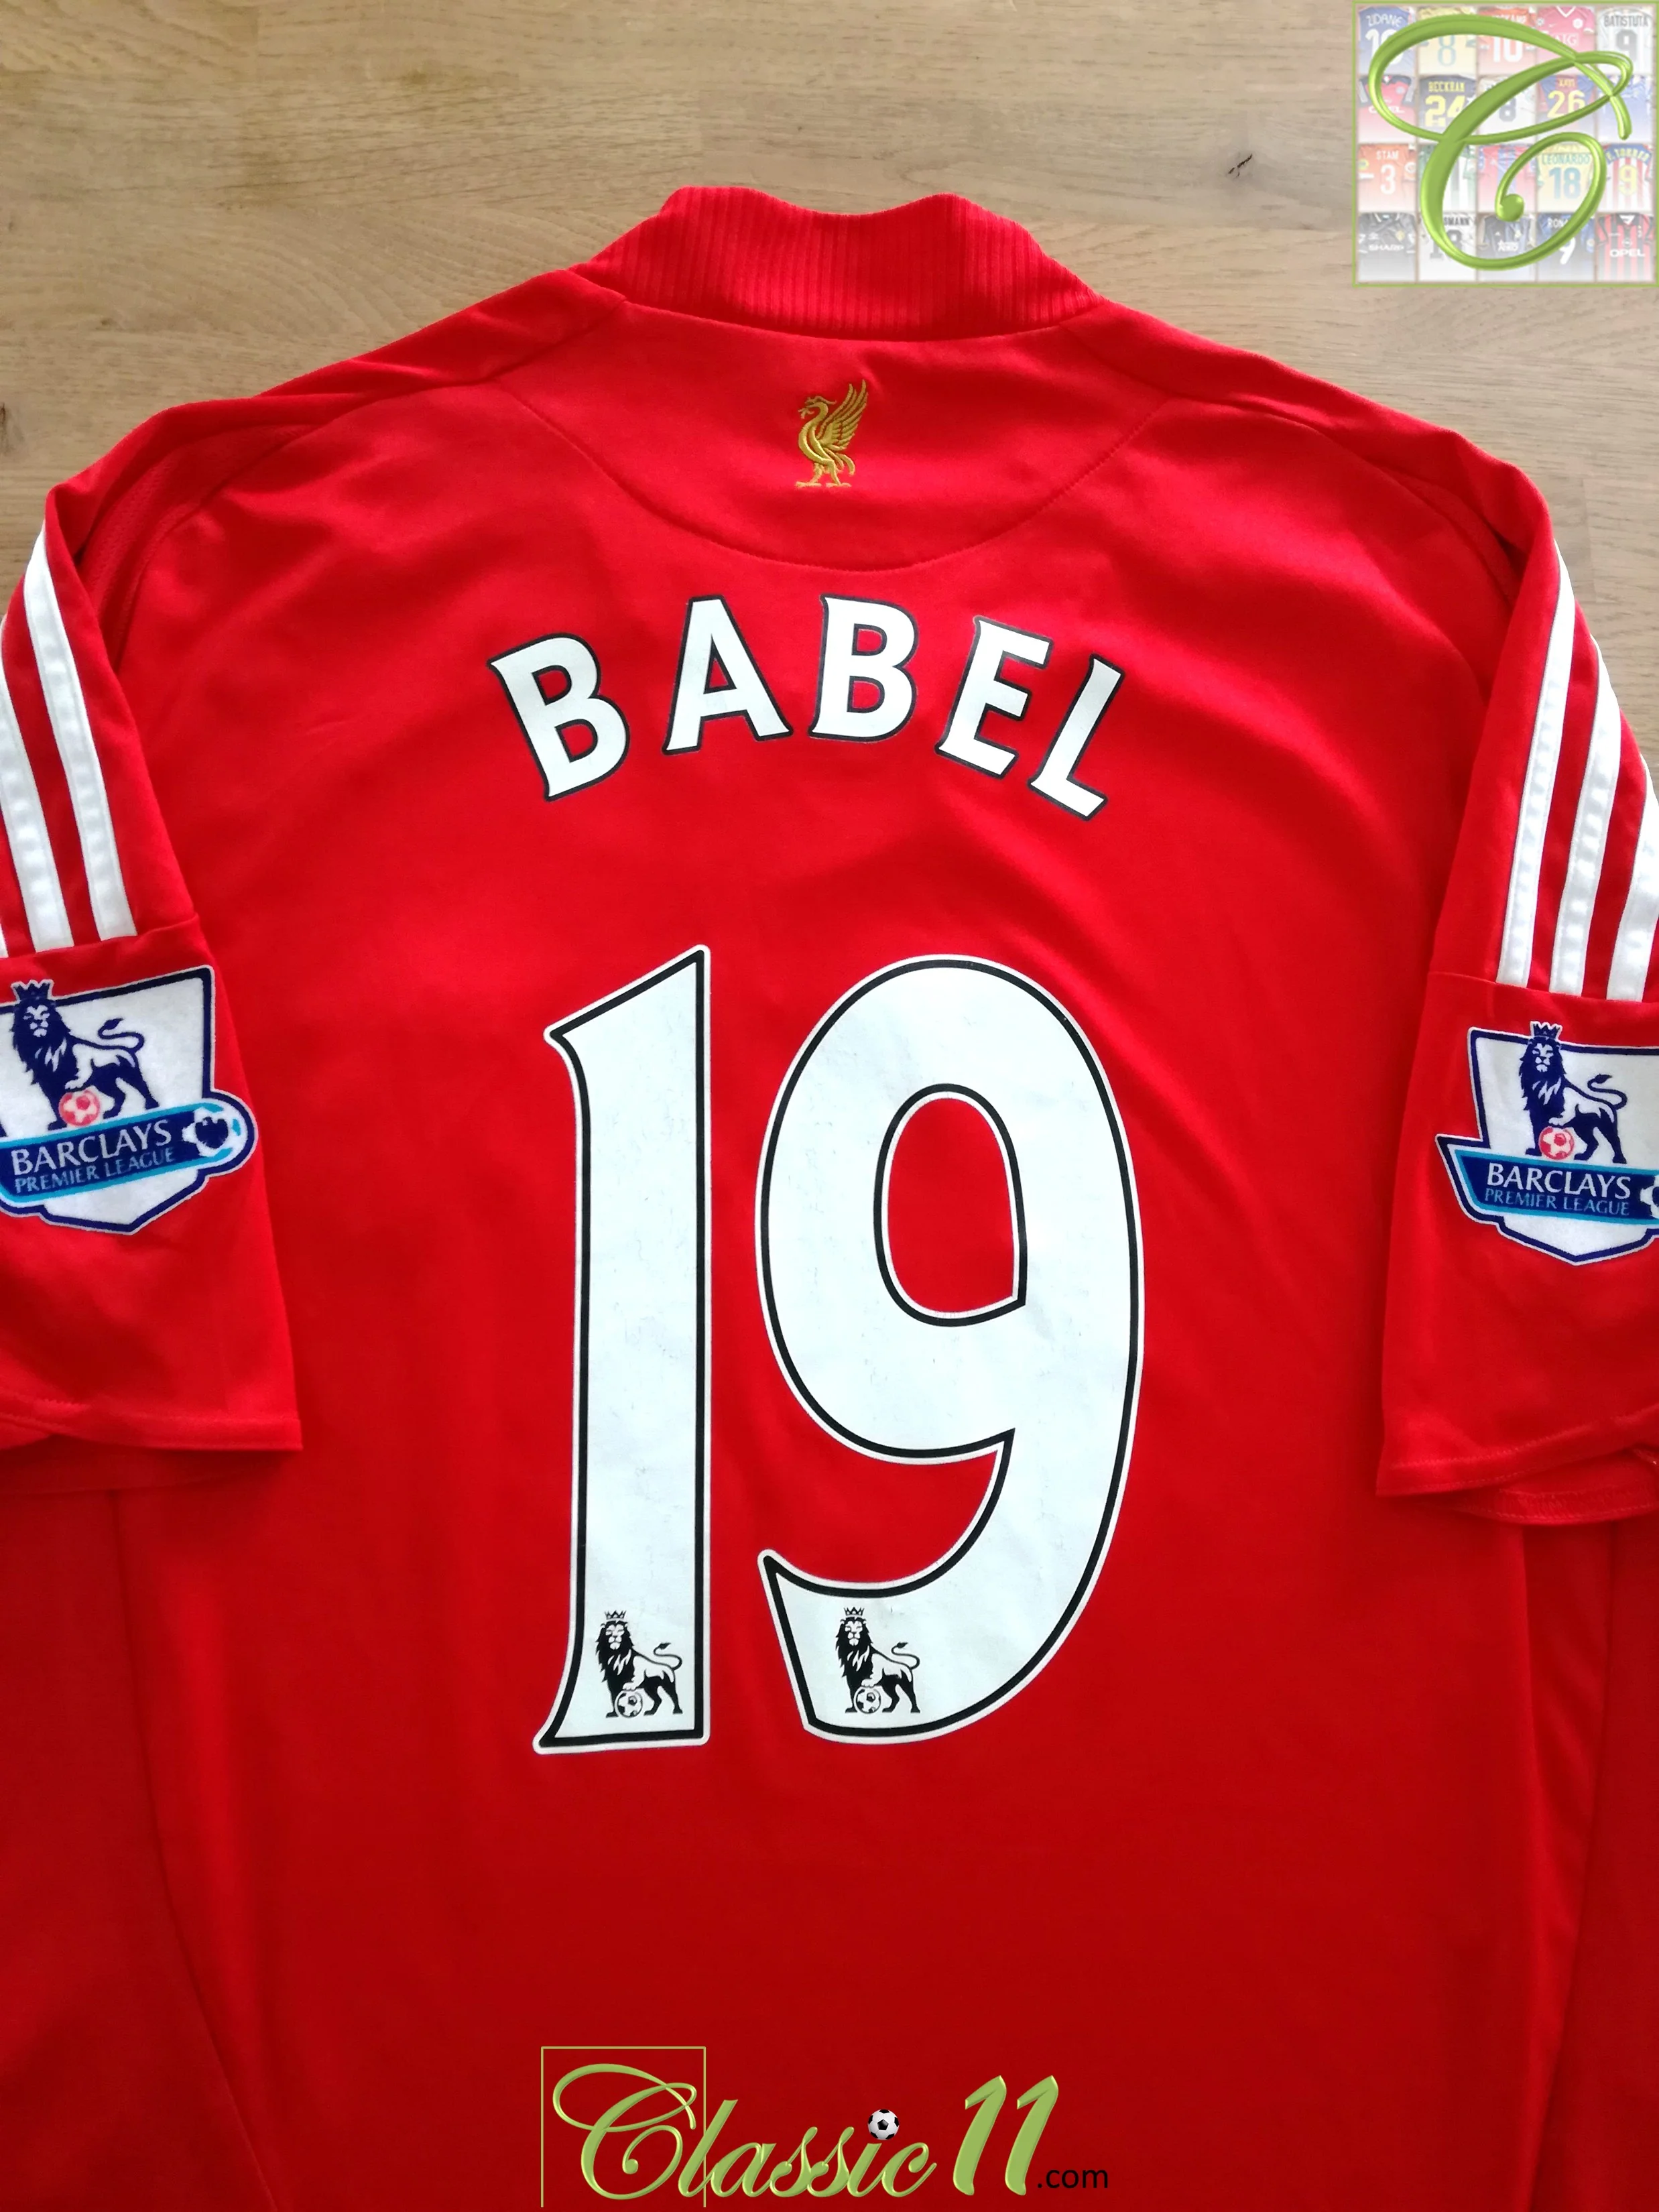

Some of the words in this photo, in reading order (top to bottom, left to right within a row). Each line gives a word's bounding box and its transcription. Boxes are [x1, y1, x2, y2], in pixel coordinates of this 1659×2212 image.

[487, 595, 1125, 820] BABEL
[11, 1119, 172, 1176] BARCLAYS
[15, 1167, 99, 1194] PREMIER
[105, 1147, 177, 1175] LEAGUE
[1484, 1188, 1558, 1209] PREMIER
[1563, 1197, 1630, 1216] LEAGUE
[1487, 1162, 1632, 1200] BARCLAYS
[533, 944, 1145, 1756] 19
